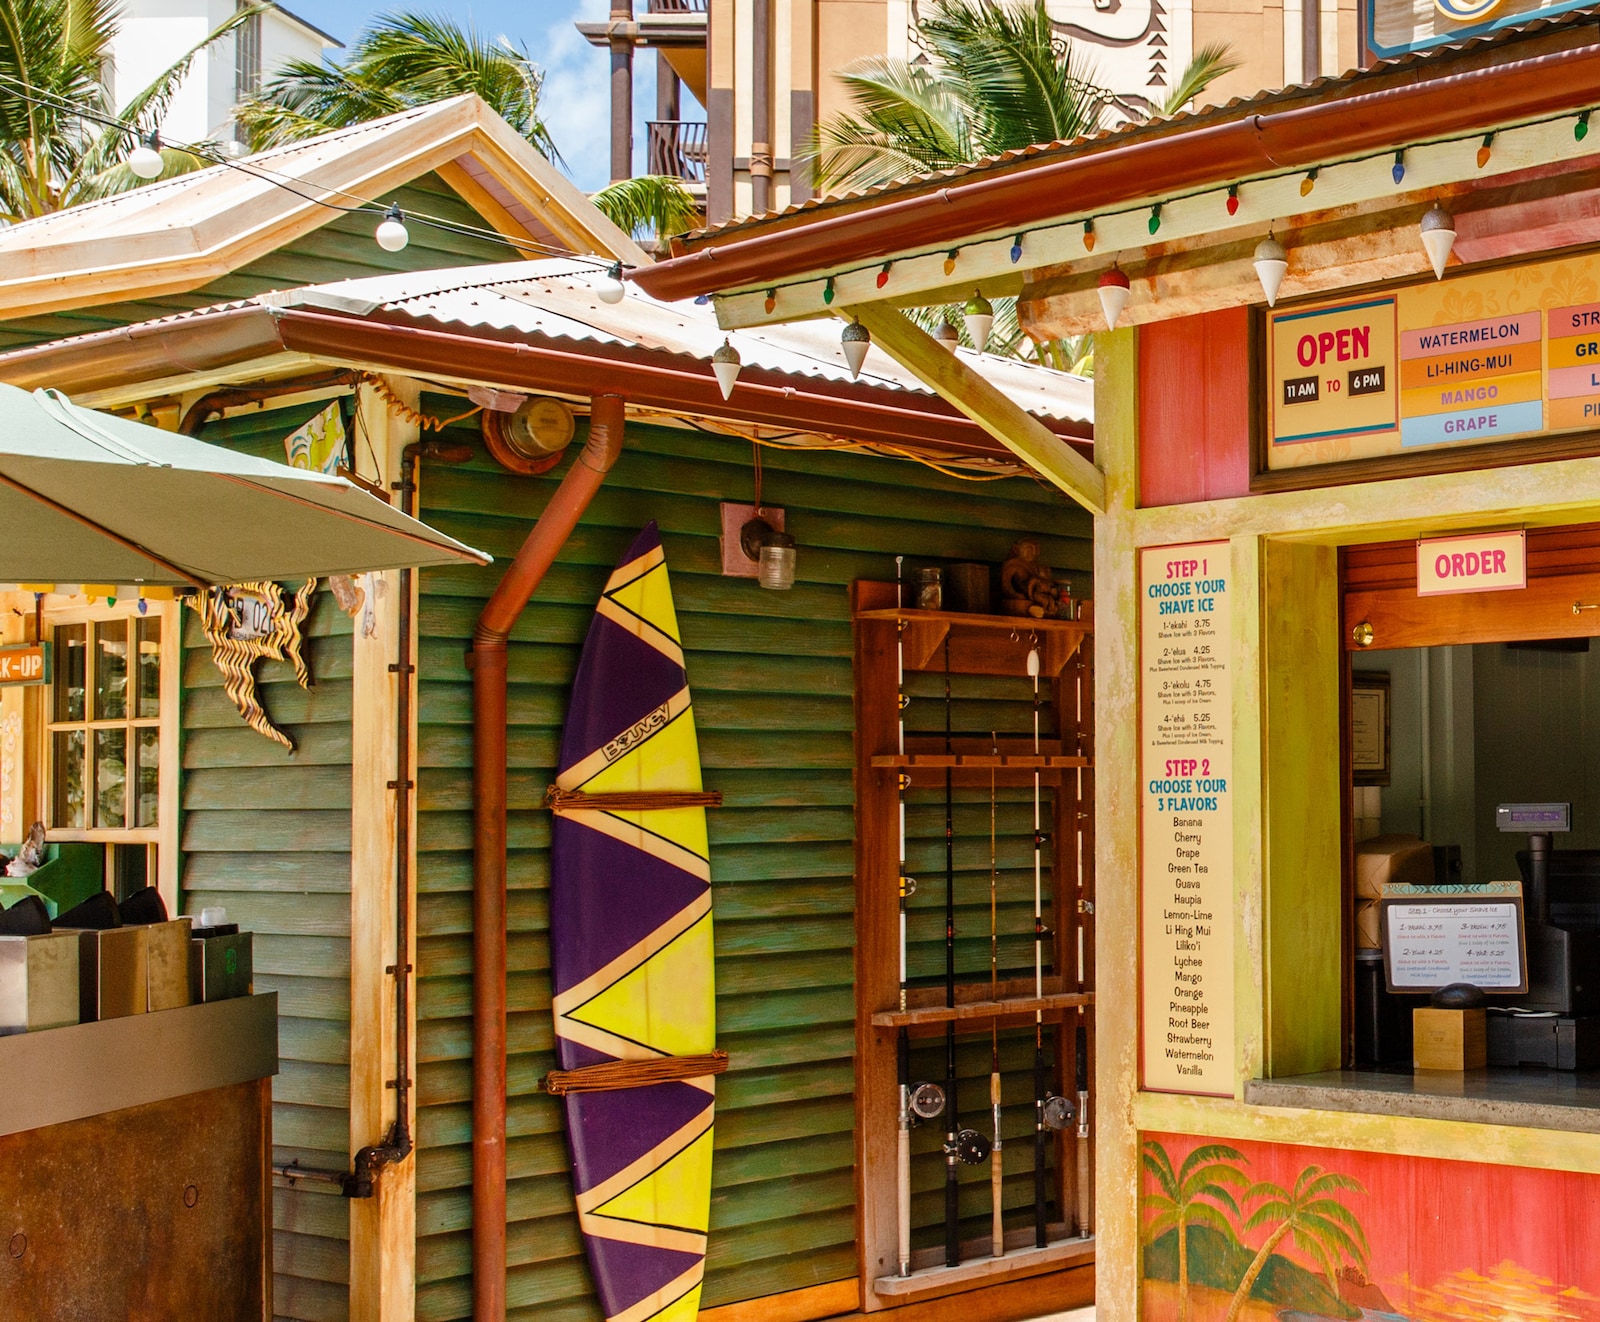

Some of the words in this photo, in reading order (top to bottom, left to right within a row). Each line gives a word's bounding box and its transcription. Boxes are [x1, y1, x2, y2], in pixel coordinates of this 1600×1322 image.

[1420, 322, 1520, 349] WATERMELON
[1297, 326, 1370, 368] OPEN
[1427, 354, 1512, 378] LI-HING-MUI
[1286, 385, 1297, 398] 11
[1298, 382, 1316, 396] AM
[1326, 380, 1340, 392] TO
[1353, 376, 1360, 388] 6
[1362, 372, 1380, 387] PM
[1441, 385, 1498, 405] MANGO
[1444, 414, 1498, 434] GRAPE
[1166, 560, 1198, 579] STEP
[1203, 559, 1207, 576] 1
[1434, 550, 1506, 578] ORDER
[1149, 582, 1191, 598] CHOOSE
[1195, 579, 1225, 594] YOUR
[1159, 599, 1194, 615] SHAVE
[1198, 598, 1214, 612] ICE
[1194, 619, 1211, 628] 3.75
[1194, 646, 1211, 654] 4.25
[0, 654, 42, 678] K-UP
[1195, 679, 1211, 688] 4.75
[1194, 713, 1211, 722] 5.25
[1166, 759, 1197, 777] STEP
[1202, 759, 1210, 776] 2
[1149, 780, 1192, 794] CHOOSE
[1195, 779, 1226, 793] YOUR
[1158, 798, 1164, 811] 3
[1168, 797, 1217, 811] FLAVORS
[1173, 817, 1202, 827] Banana
[1174, 832, 1201, 845] Cherry
[1176, 848, 1200, 860] Grape
[1168, 863, 1191, 873] Green
[1194, 863, 1208, 873] Tea
[1176, 878, 1200, 889] Guava
[1174, 894, 1202, 907] Haupia
[1164, 909, 1212, 920] Lemon-Lime
[1166, 925, 1172, 935] Li
[1175, 925, 1193, 938] Hing
[1196, 925, 1211, 936] Mui
[1176, 940, 1201, 951] Liliko'i
[1174, 956, 1203, 969] Lychee
[1175, 971, 1202, 985] Mango
[1174, 987, 1203, 1000] Orange
[1170, 1002, 1208, 1016] Pineapple
[1169, 1017, 1188, 1028] Root
[1191, 1019, 1210, 1029] Beer
[1167, 1032, 1212, 1048] Strawberry
[1165, 1048, 1214, 1061] Watermelon
[1177, 1064, 1203, 1076] Vanilla
